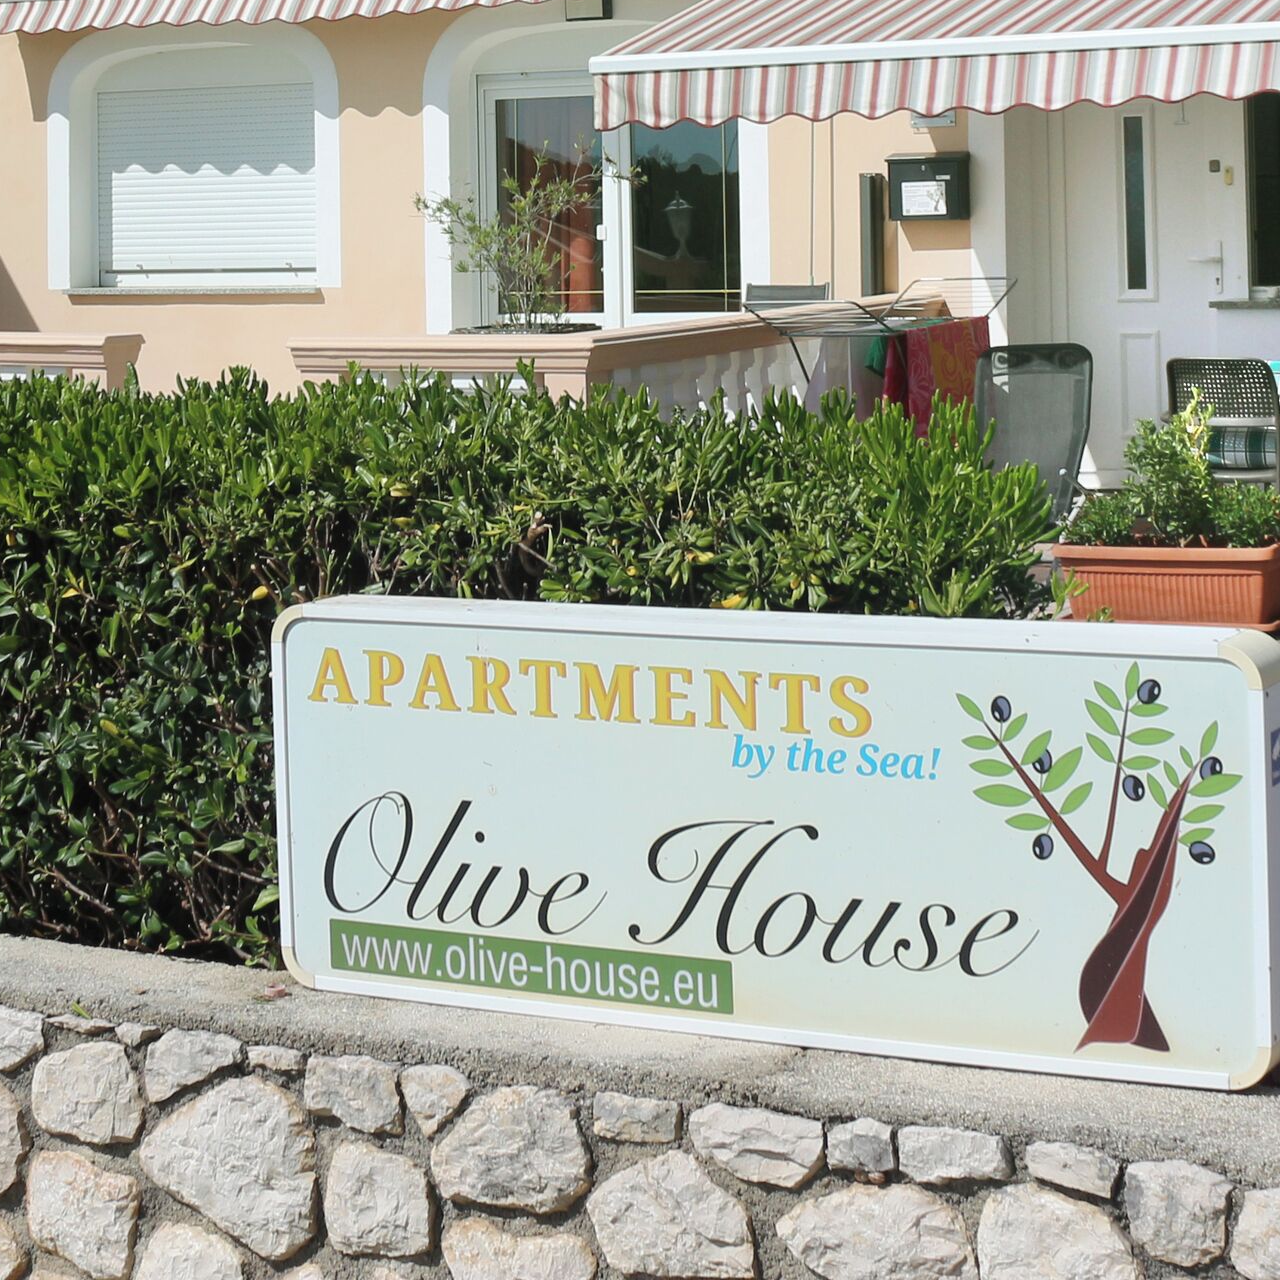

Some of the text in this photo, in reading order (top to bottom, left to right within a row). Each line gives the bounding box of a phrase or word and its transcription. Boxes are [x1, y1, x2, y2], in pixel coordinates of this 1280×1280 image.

[307, 646, 873, 739] APARTMENTS
[730, 734, 942, 781] by the Sea!
[323, 791, 1040, 978] Olive House
[340, 932, 720, 1009] www.olive-house.eu
